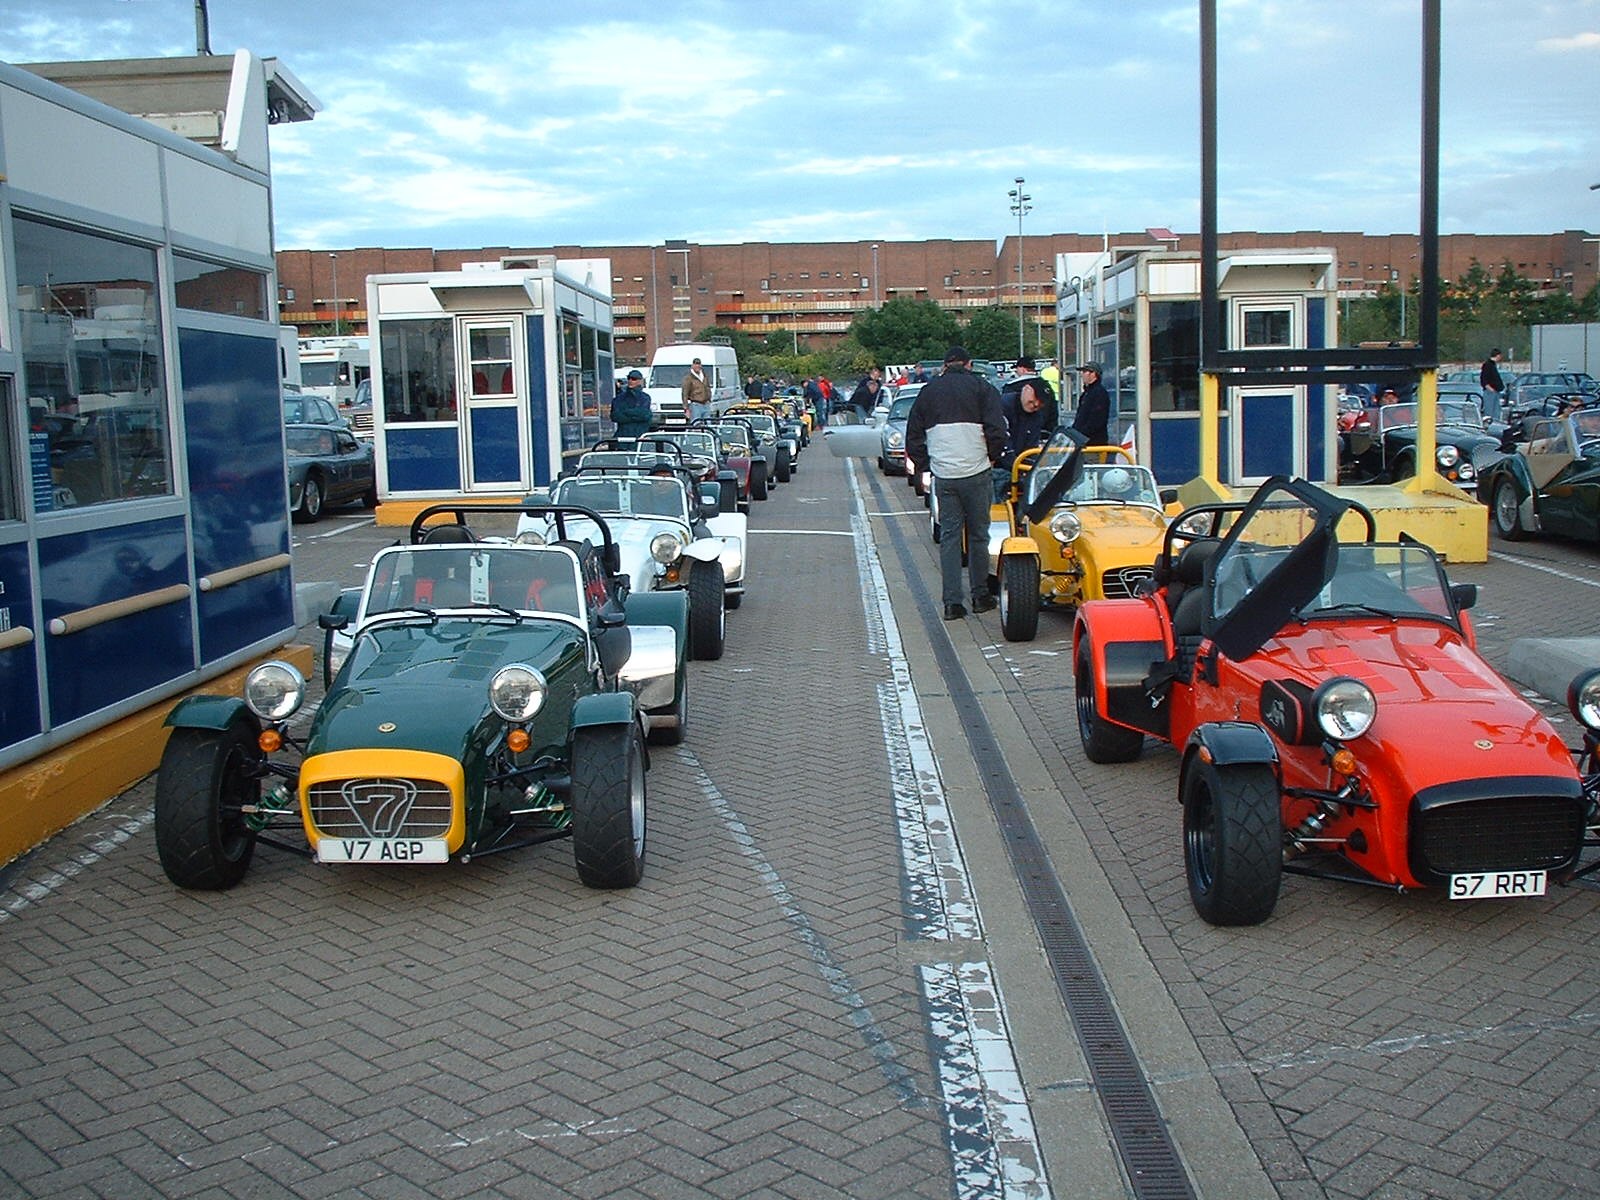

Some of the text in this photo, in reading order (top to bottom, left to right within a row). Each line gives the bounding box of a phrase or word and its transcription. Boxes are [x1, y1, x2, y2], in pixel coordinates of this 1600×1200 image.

[352, 783, 408, 833] 7
[342, 841, 424, 860] V7 AGP
[1453, 872, 1544, 896] S7 RRT
